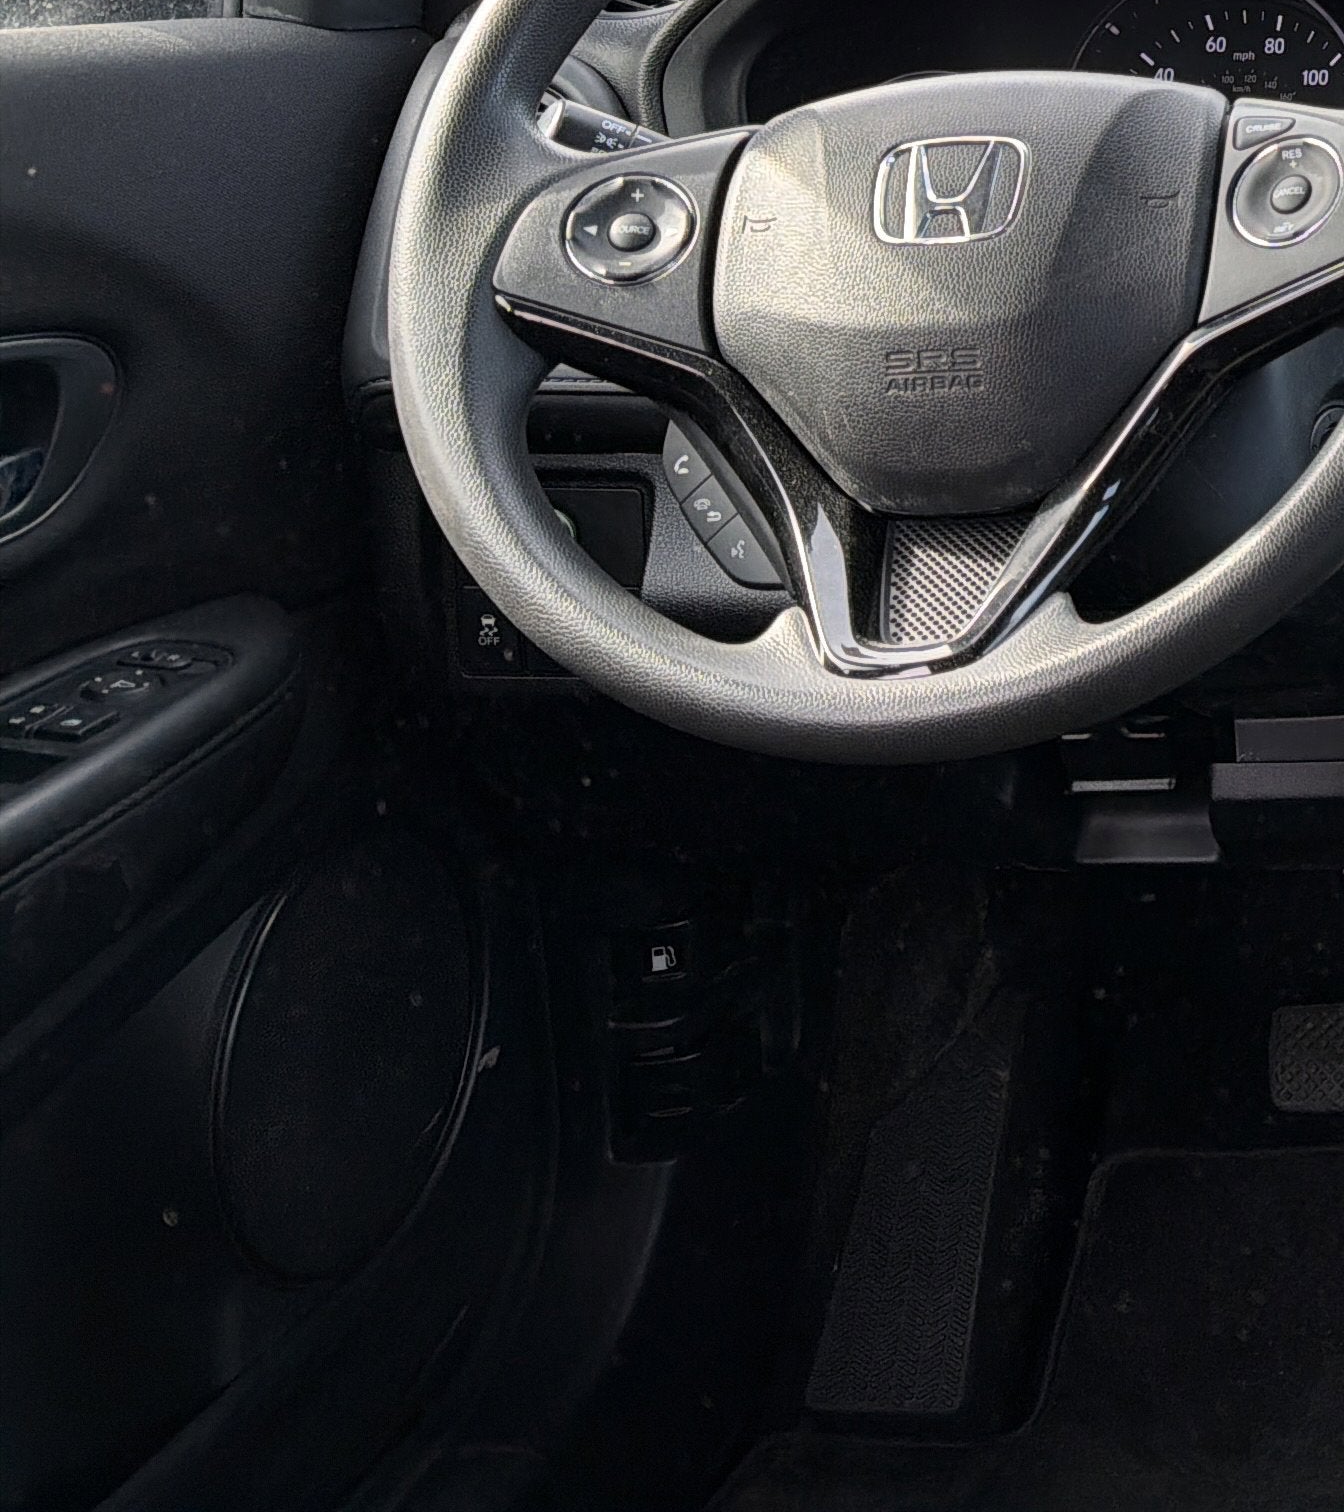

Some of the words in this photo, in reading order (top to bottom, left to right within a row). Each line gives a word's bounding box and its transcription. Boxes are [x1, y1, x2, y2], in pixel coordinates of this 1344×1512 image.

[1205, 37, 1227, 53] 60
[1264, 37, 1285, 54] 80
[1232, 50, 1256, 63] mph
[1302, 69, 1329, 86] 100
[601, 119, 626, 134] OFF
[1281, 148, 1303, 161] RES
[613, 223, 650, 234] OURCE
[477, 636, 501, 646] OFF
